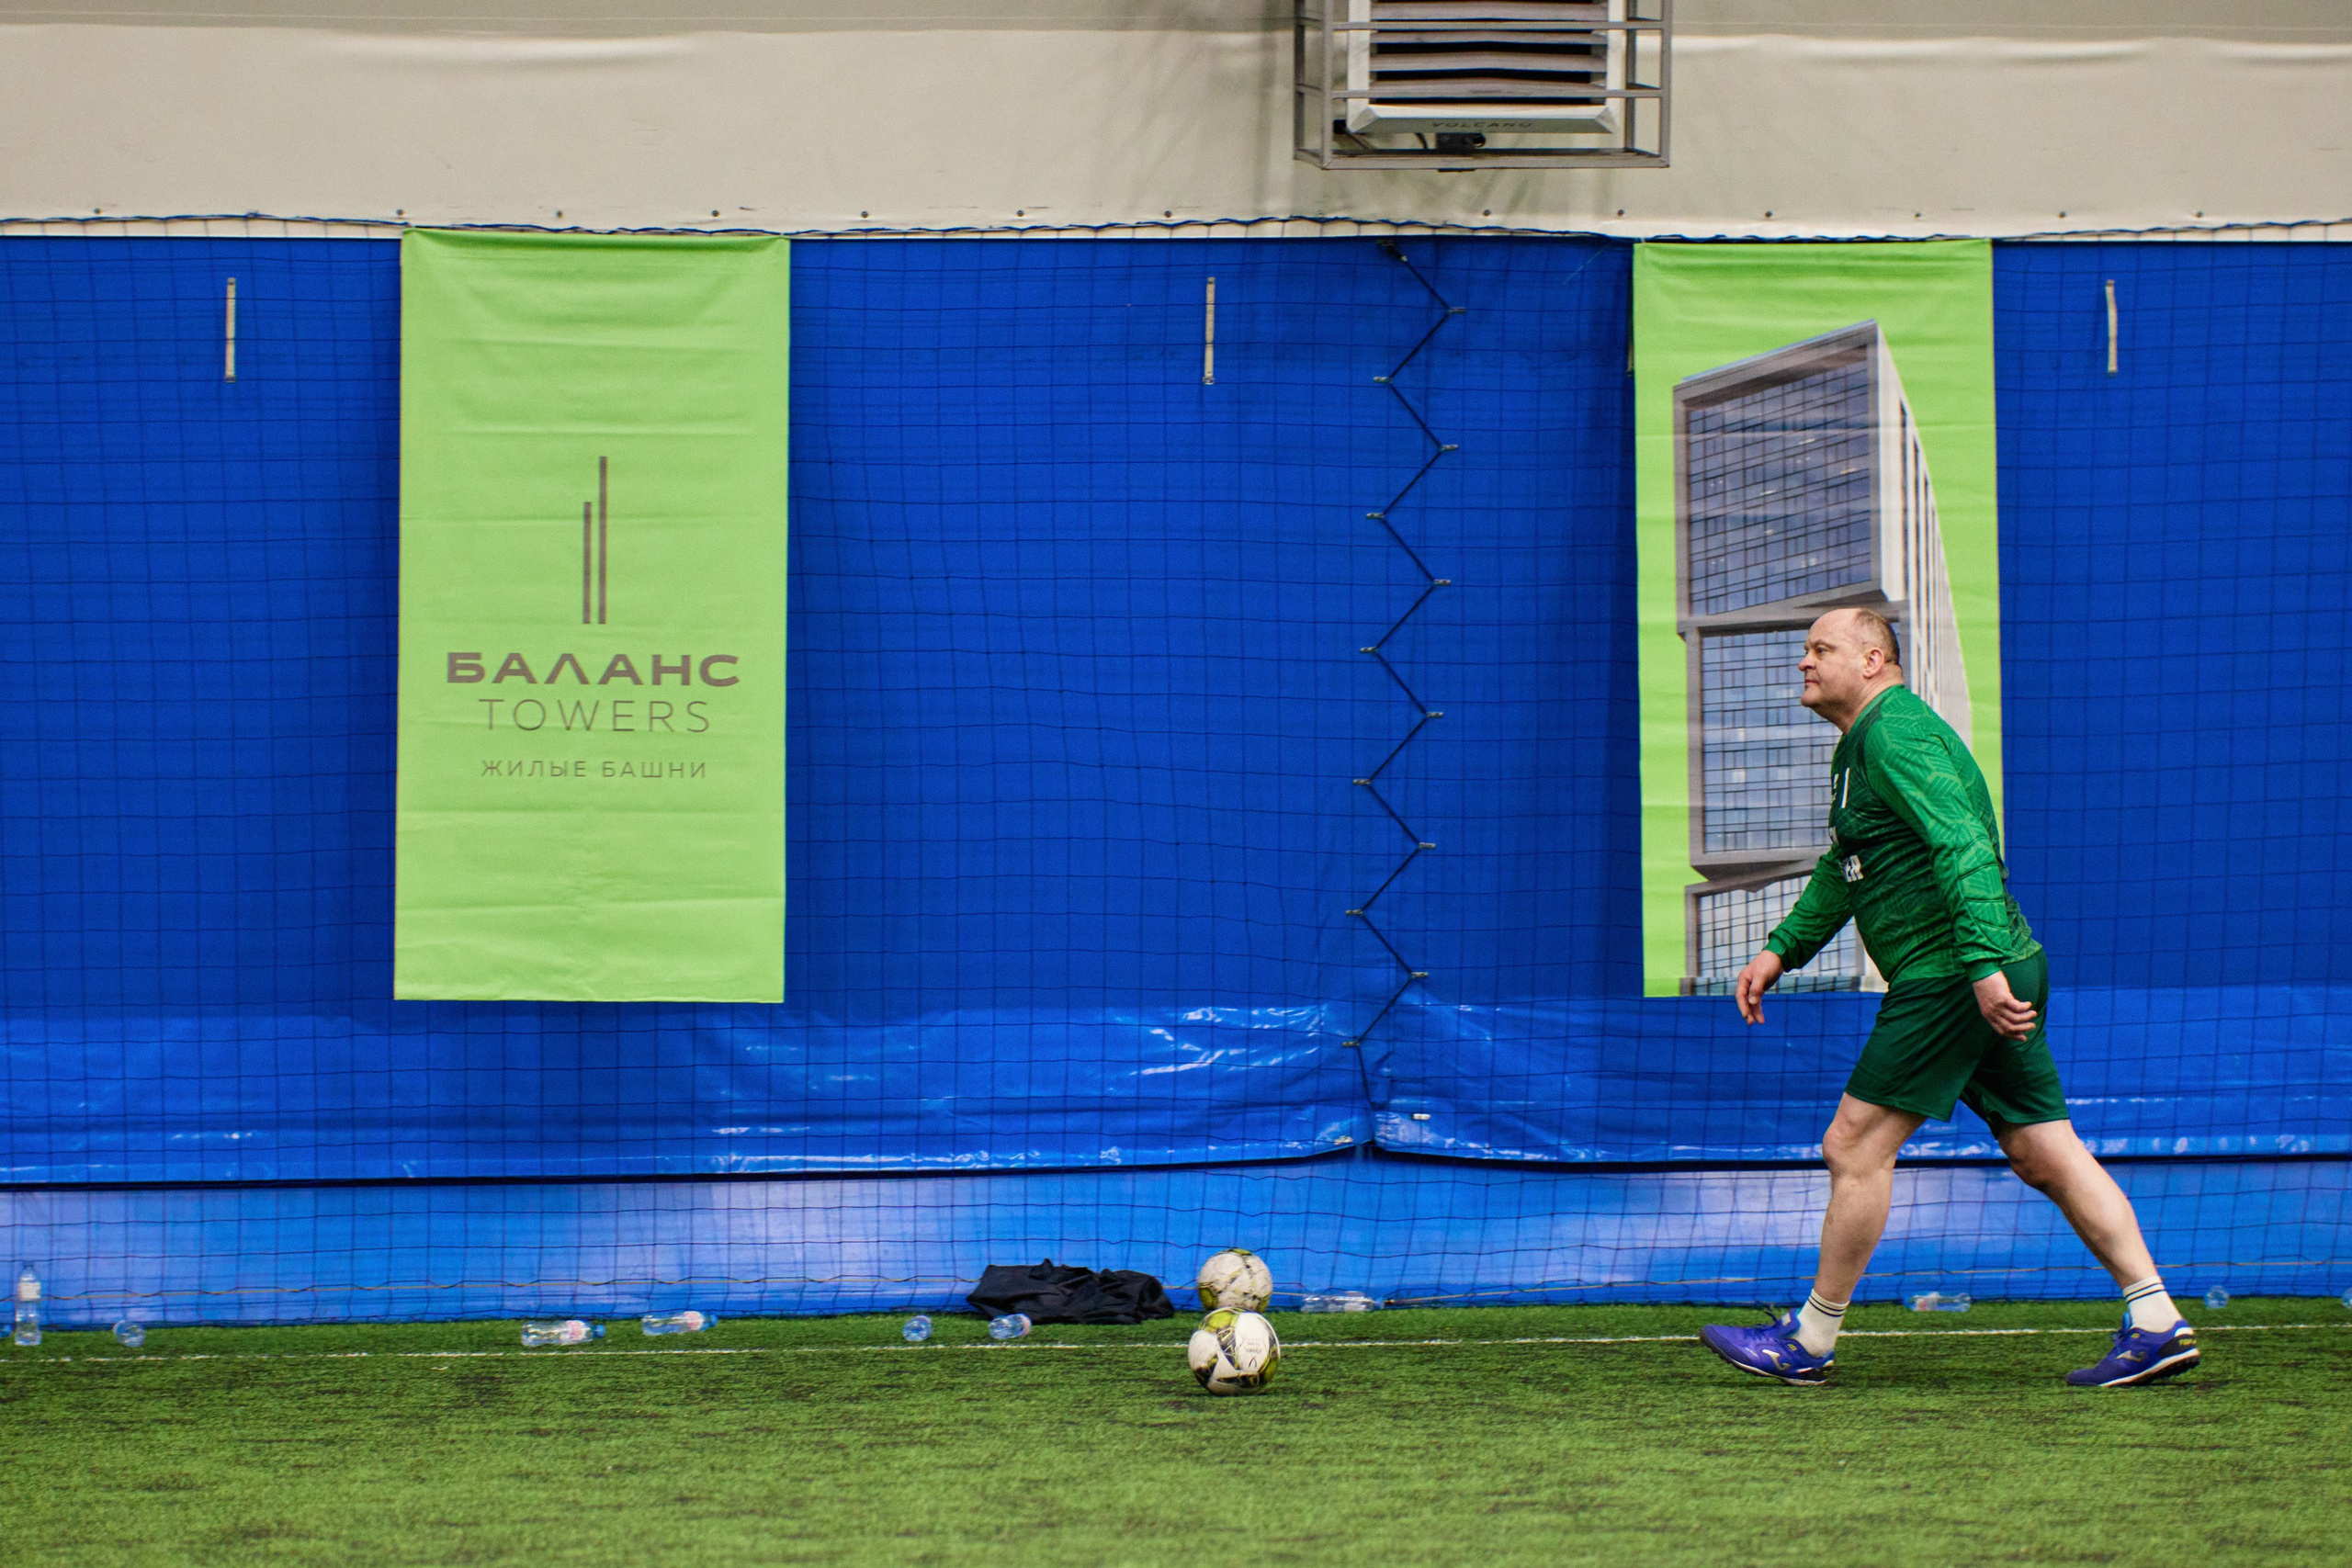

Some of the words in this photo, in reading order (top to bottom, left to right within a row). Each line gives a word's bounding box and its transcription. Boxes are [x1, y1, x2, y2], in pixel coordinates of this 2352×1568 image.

[447, 652, 741, 687] БАЛАНС
[478, 698, 709, 733] TOWERS
[481, 760, 588, 778] ЖИЛЫЕ
[602, 761, 707, 778] БАШНИ
